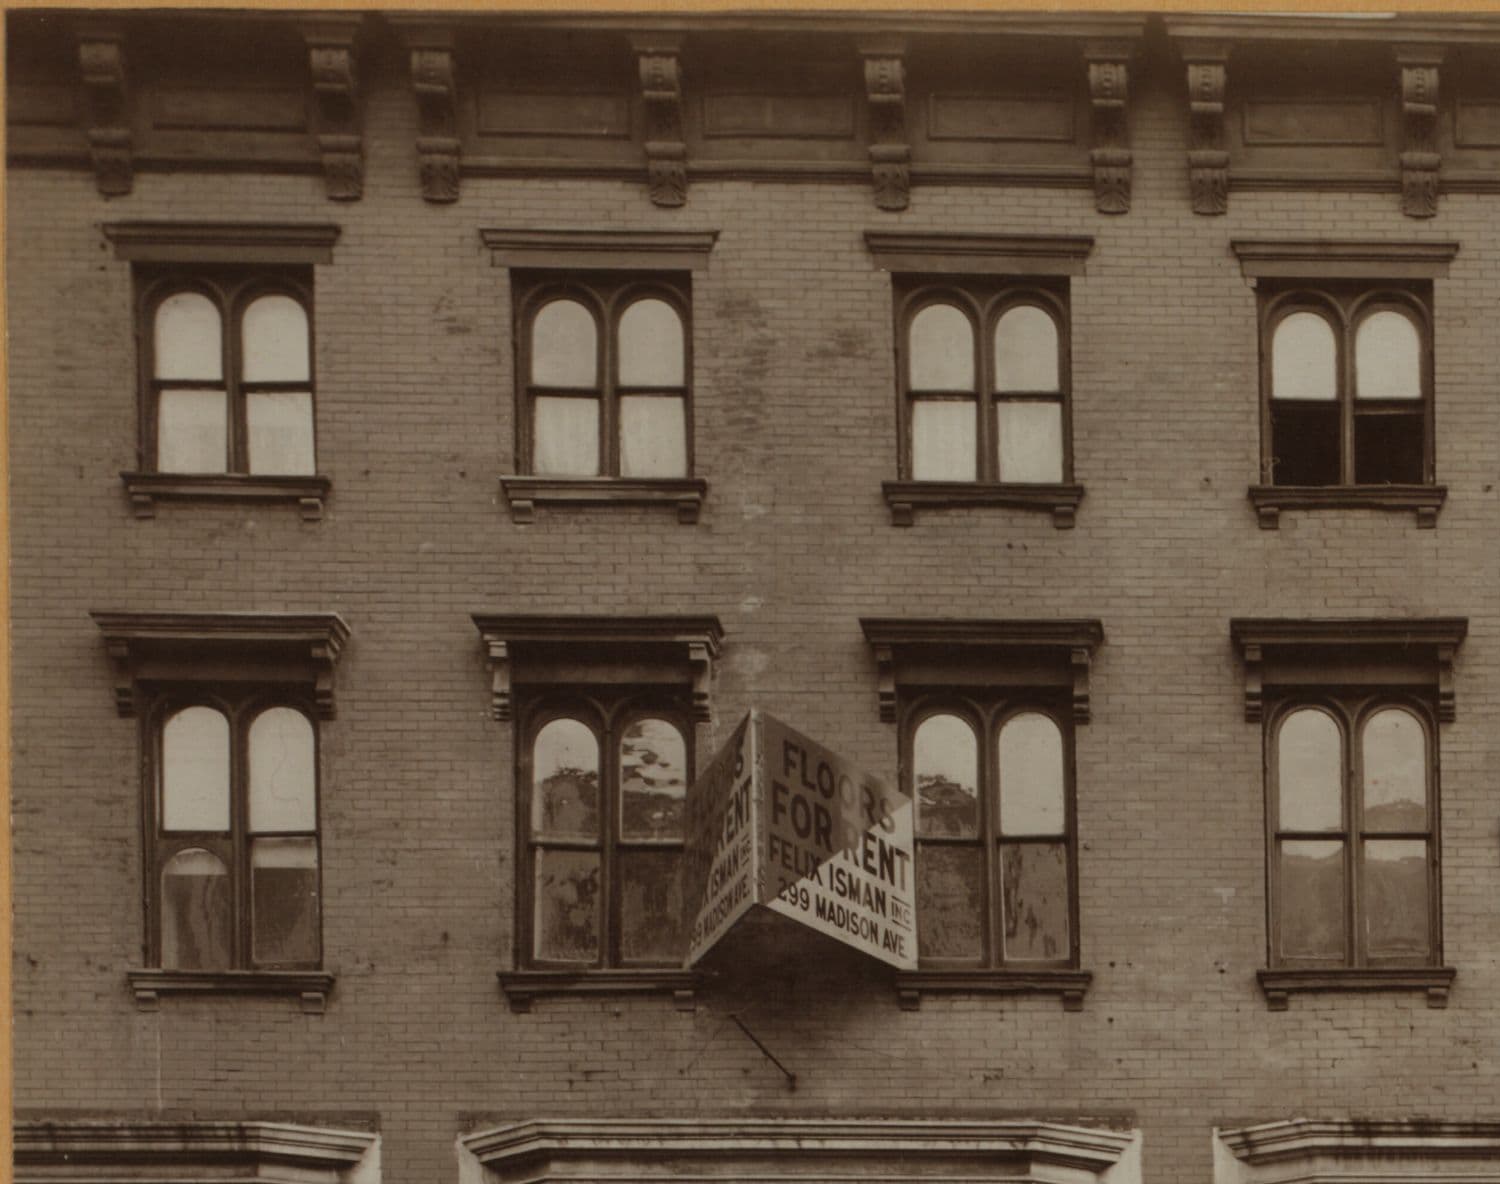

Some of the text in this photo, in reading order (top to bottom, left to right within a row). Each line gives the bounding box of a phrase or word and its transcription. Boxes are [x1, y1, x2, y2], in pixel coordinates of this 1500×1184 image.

[772, 780, 833, 852] FOR
[783, 738, 896, 834] FLOORS
[769, 834, 823, 886] FELIX
[829, 862, 887, 918] ISMAN
[777, 876, 811, 912] 299
[816, 893, 879, 945] MADISON
